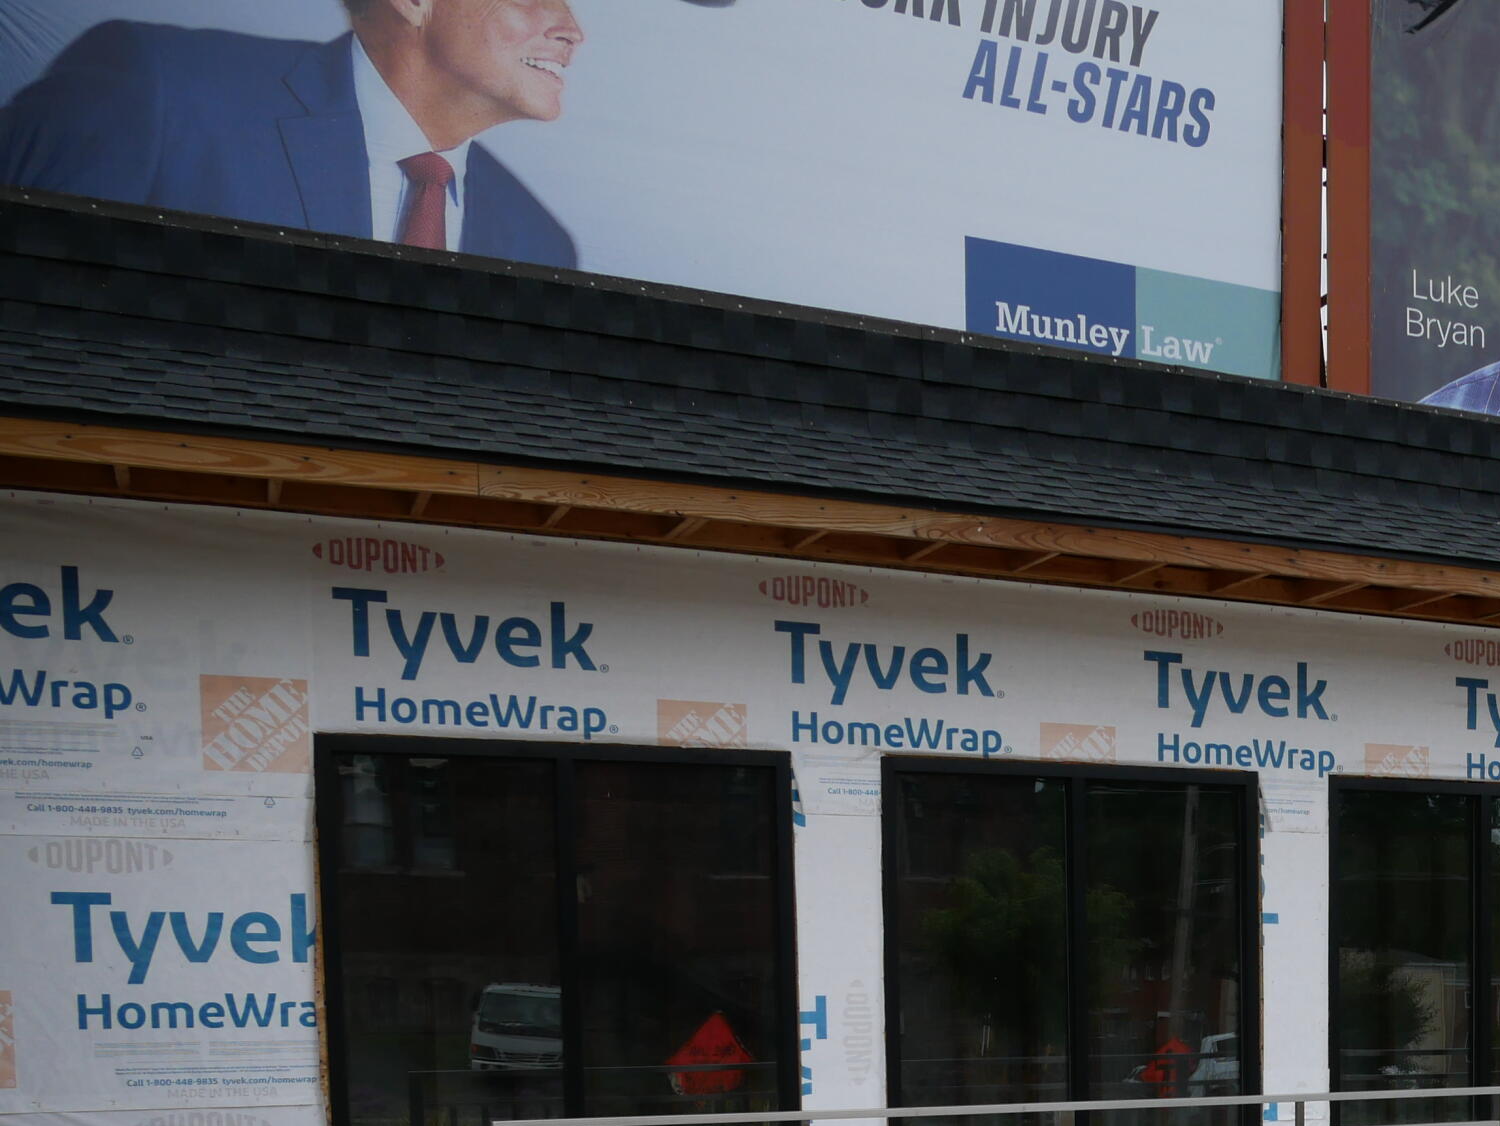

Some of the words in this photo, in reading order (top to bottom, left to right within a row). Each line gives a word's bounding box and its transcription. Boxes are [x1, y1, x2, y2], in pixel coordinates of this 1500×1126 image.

[980, 0, 1159, 67] INJURY
[962, 39, 1215, 148] ALL-STARS
[1412, 269, 1479, 309] Luke
[995, 301, 1129, 356] Munley
[1141, 326, 1214, 365] Law
[1406, 308, 1485, 350] Bryan
[330, 538, 431, 572] DUPONT
[773, 576, 857, 608] DUPONT
[332, 587, 597, 680] Tyvek
[1142, 610, 1213, 640] DUPONT
[774, 620, 994, 705] Tyvek
[212, 686, 256, 723] THE
[355, 686, 607, 740] HomeWrap
[1144, 650, 1329, 728] Tyvek
[204, 680, 306, 770] HOME
[792, 711, 1002, 758] HomeWrap
[1158, 733, 1335, 778] HomeWrap
